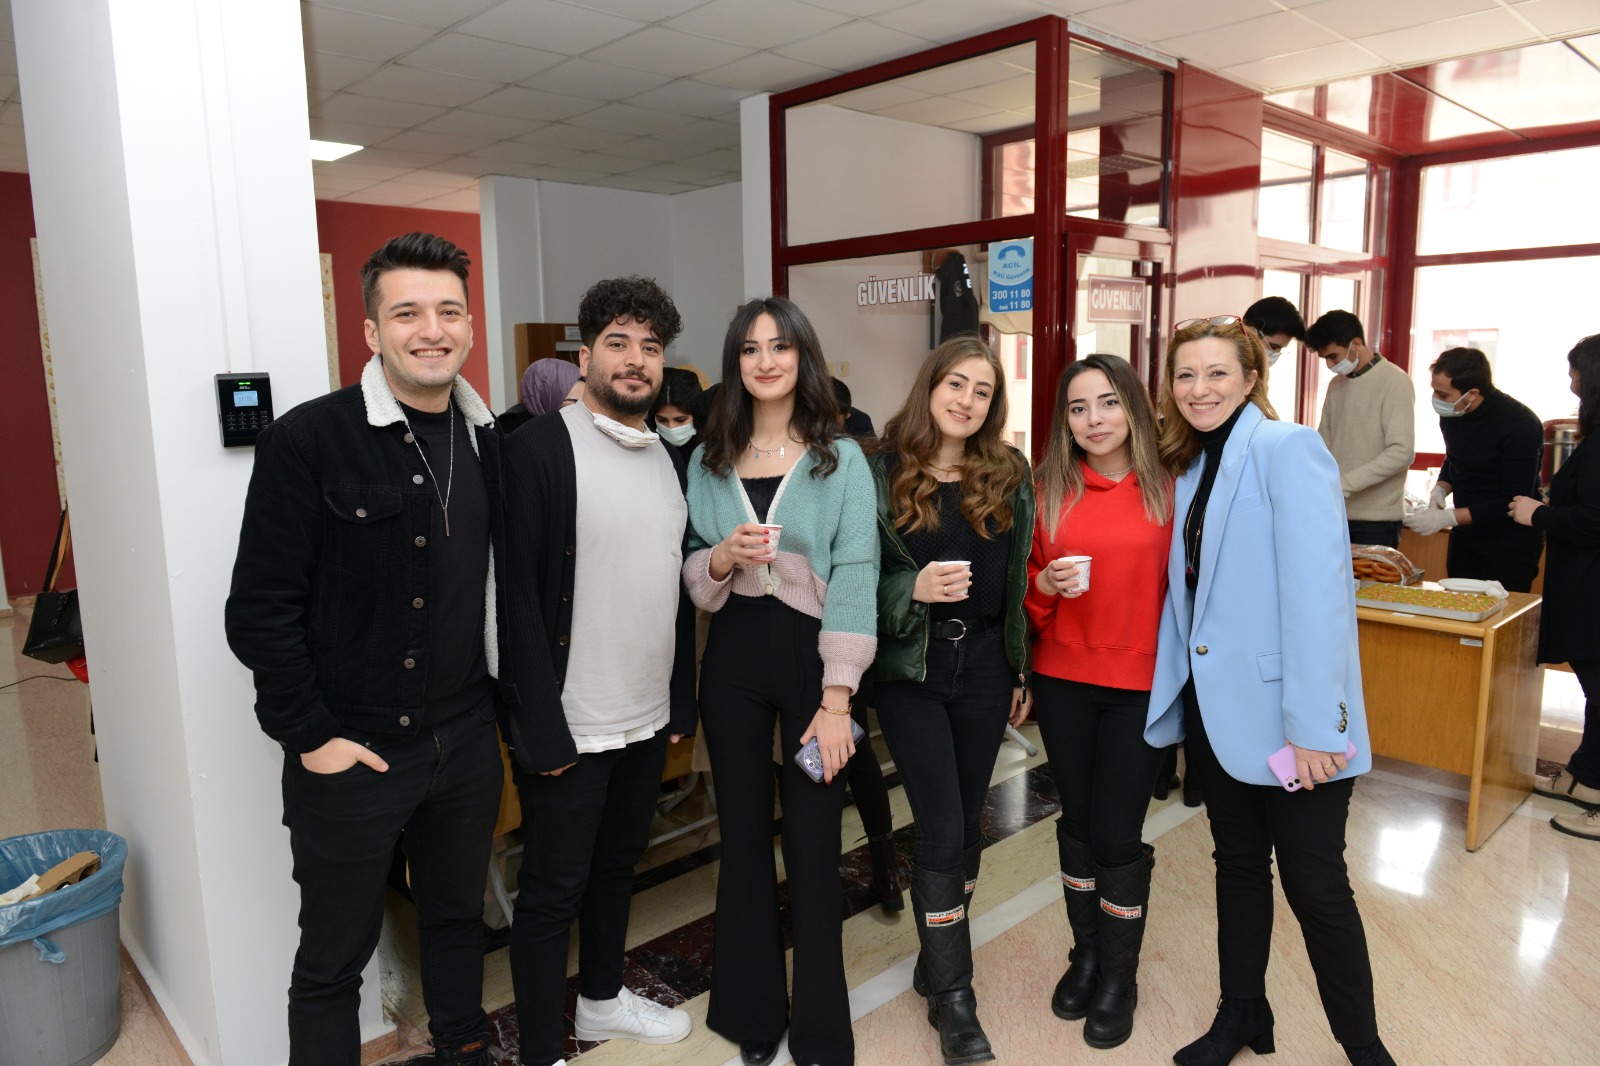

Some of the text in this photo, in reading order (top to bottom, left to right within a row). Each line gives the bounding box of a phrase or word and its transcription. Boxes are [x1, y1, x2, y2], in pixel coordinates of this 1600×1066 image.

[856, 270, 935, 306] GÜVENLİK
[992, 289, 1031, 300] 300 11 80
[1091, 283, 1142, 311] GÜVENLİK
[1009, 301, 1018, 309] 11
[1020, 300, 1031, 309] 80
